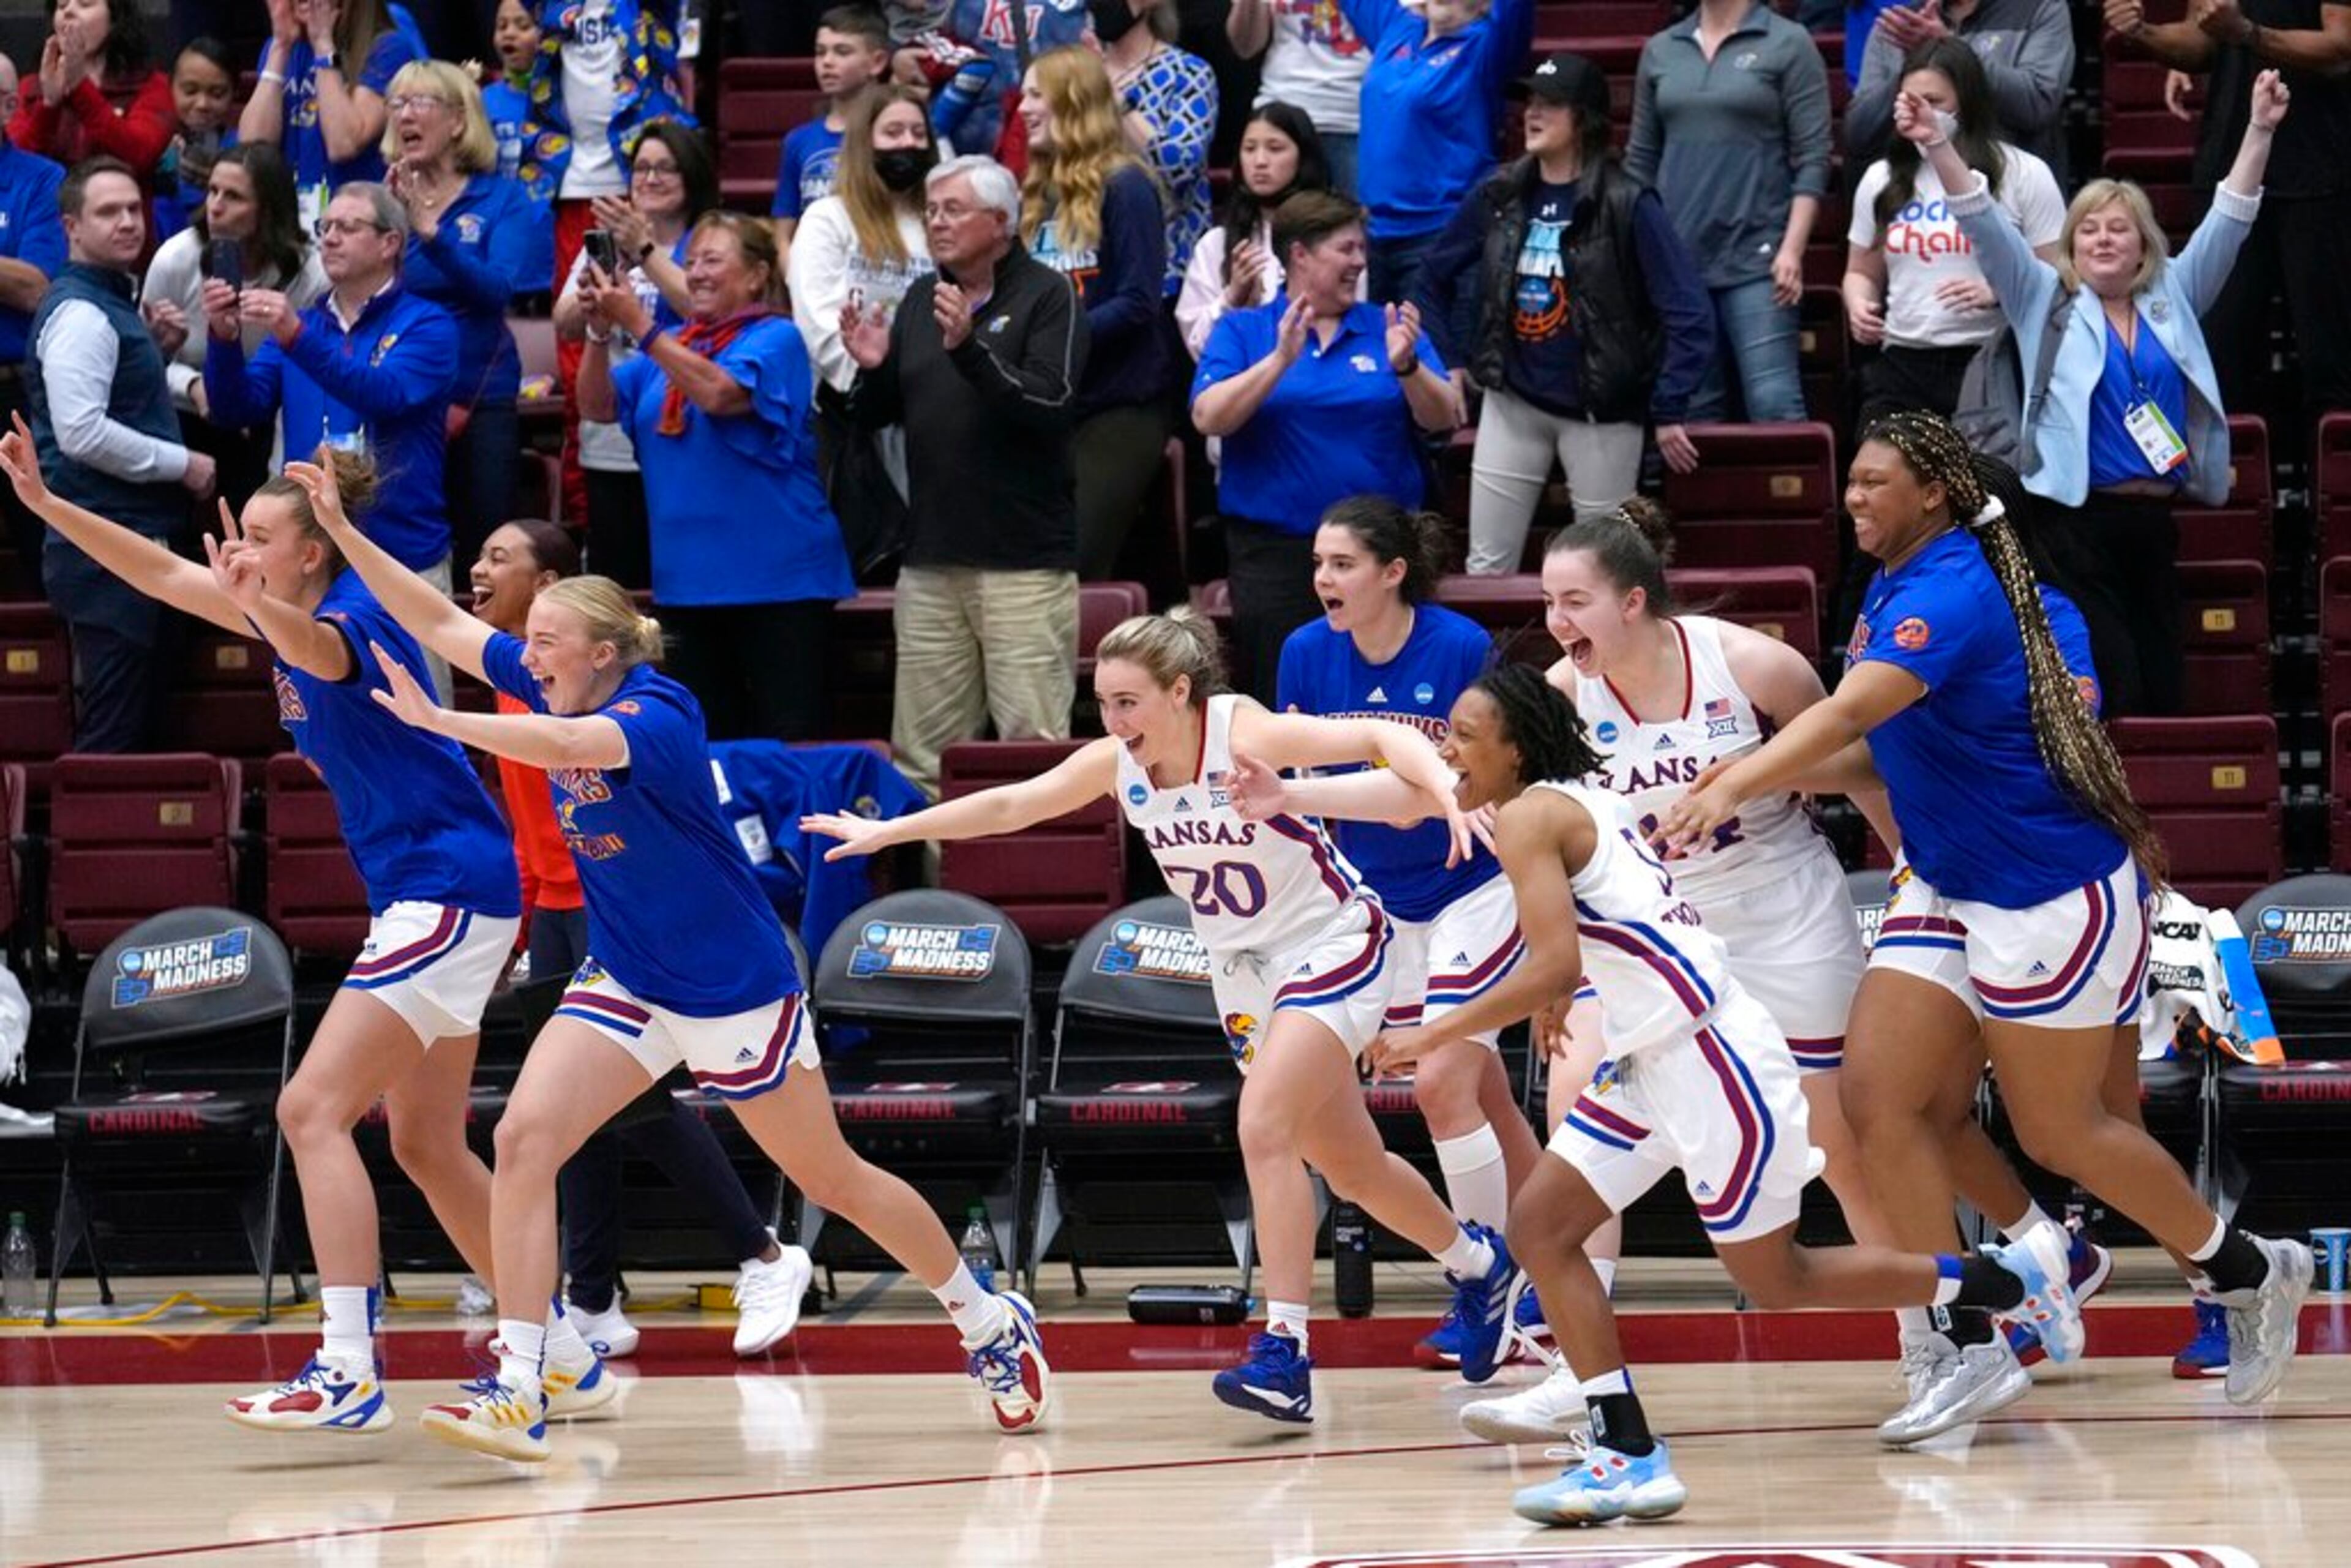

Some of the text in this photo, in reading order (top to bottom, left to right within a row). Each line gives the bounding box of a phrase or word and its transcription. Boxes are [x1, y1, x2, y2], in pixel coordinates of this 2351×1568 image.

[1147, 820, 1256, 849] ANSAS
[1164, 860, 1267, 918] 20
[886, 926, 960, 949] MARCH
[2292, 932, 2351, 953] MADN
[143, 940, 212, 971] MARCH
[890, 948, 991, 971] MADNESS
[1138, 946, 1212, 974] MADNE
[154, 954, 247, 990] MADNESS
[2259, 1078, 2351, 1101] CARDIN
[88, 1108, 204, 1133] CARDINAL
[838, 1099, 955, 1120] CARDINAL
[1070, 1100, 1188, 1125] CARDINAL
